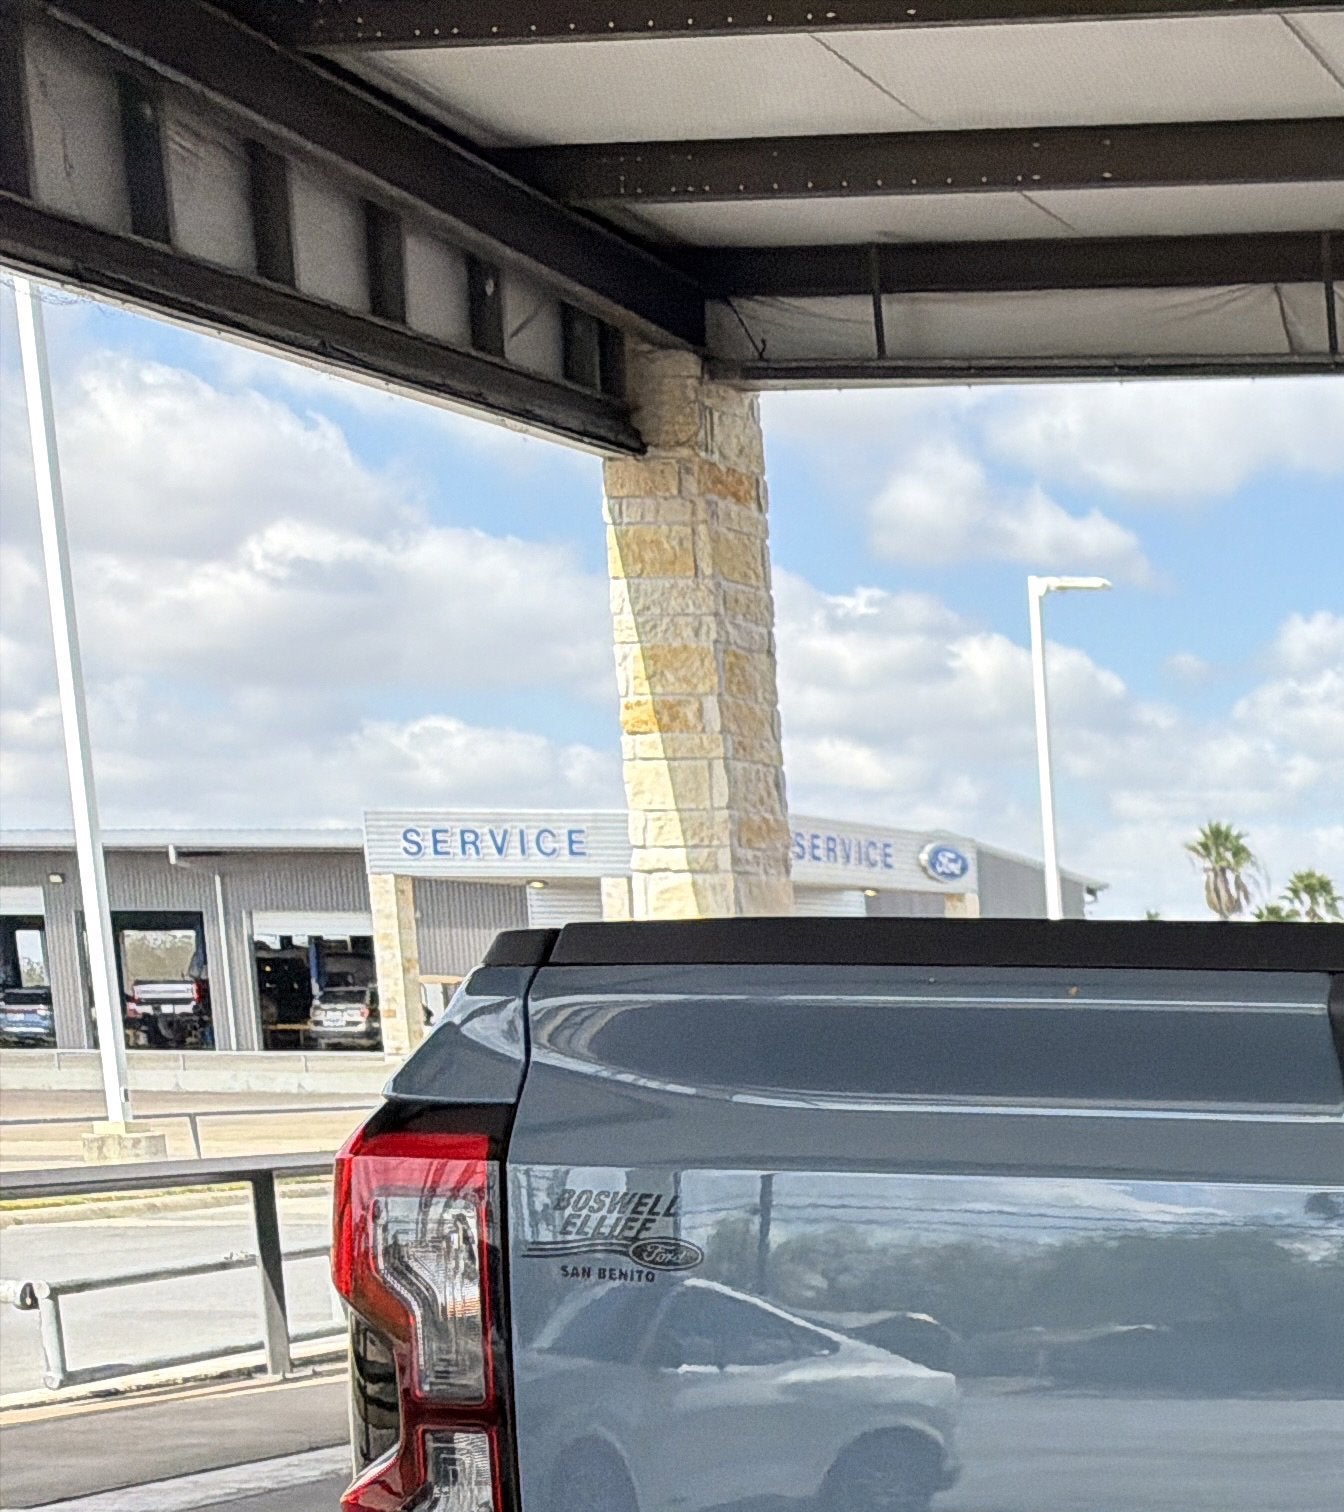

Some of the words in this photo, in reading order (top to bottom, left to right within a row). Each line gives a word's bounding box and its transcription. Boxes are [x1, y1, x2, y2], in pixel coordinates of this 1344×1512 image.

[402, 828, 587, 857] SERVICE
[794, 832, 894, 869] SERVICE
[554, 1188, 681, 1218] BOSWELL
[559, 1213, 657, 1241] ELLIFF
[643, 1244, 687, 1265] Ford
[561, 1265, 591, 1280] SAN
[598, 1267, 656, 1283] BENITO
